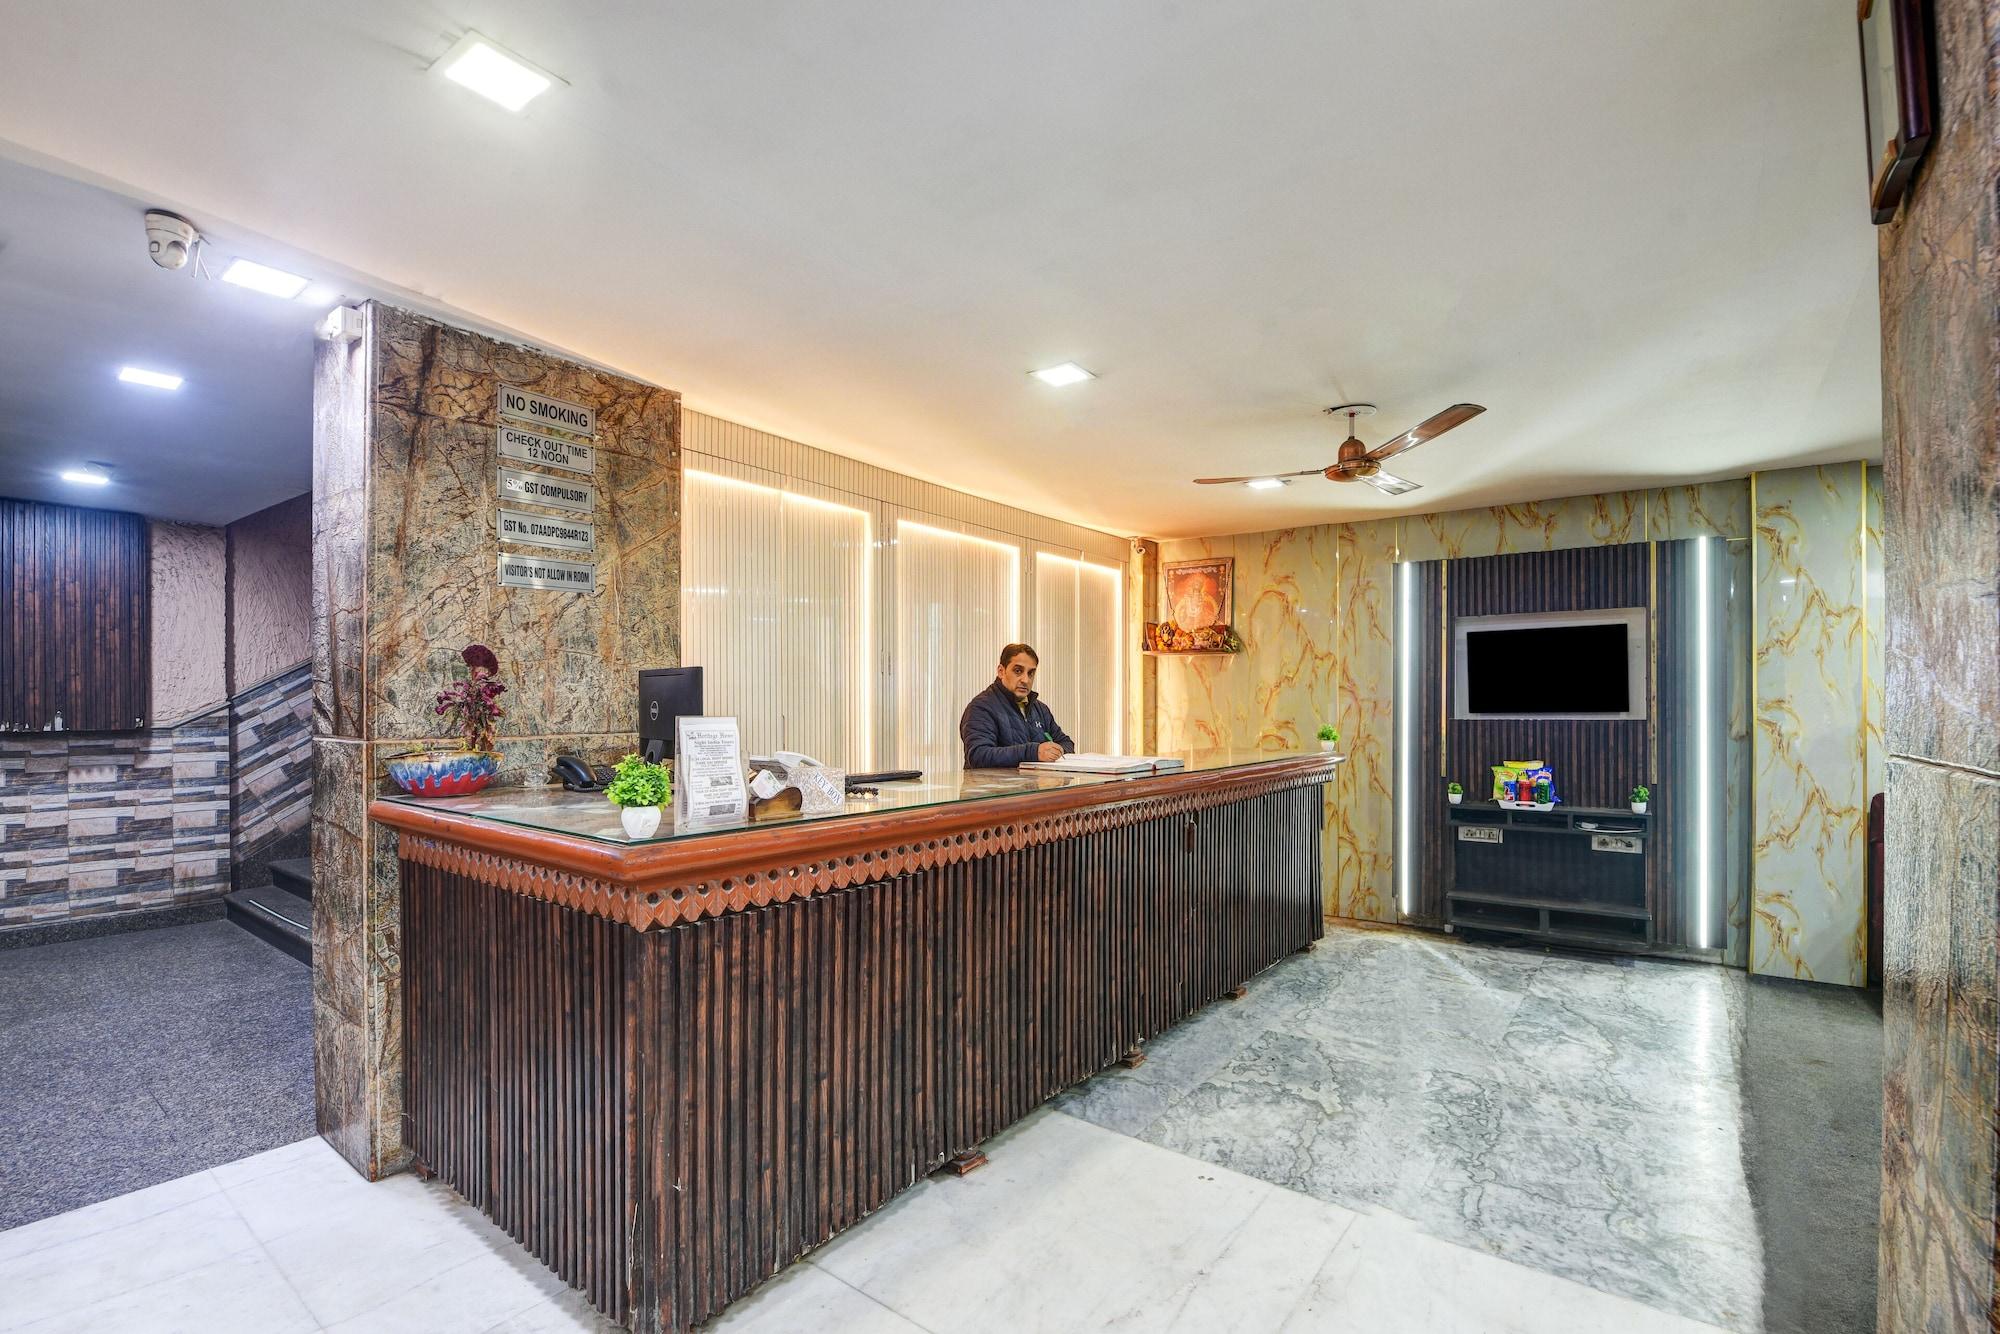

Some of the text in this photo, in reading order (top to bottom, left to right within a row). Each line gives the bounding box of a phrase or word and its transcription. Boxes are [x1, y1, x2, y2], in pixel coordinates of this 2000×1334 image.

[507, 393, 588, 427] NO SMOKING
[506, 432, 588, 459] CHECK OUT TIME
[527, 447, 569, 465] 12 NOON
[524, 481, 539, 494] GST
[540, 484, 588, 503] COMPULSORY
[503, 519, 517, 532] GST
[518, 521, 529, 534] No.
[504, 564, 590, 583] VISITOR'S NOT ALLOW IN ROOM
[813, 772, 842, 803] KEY BOX
